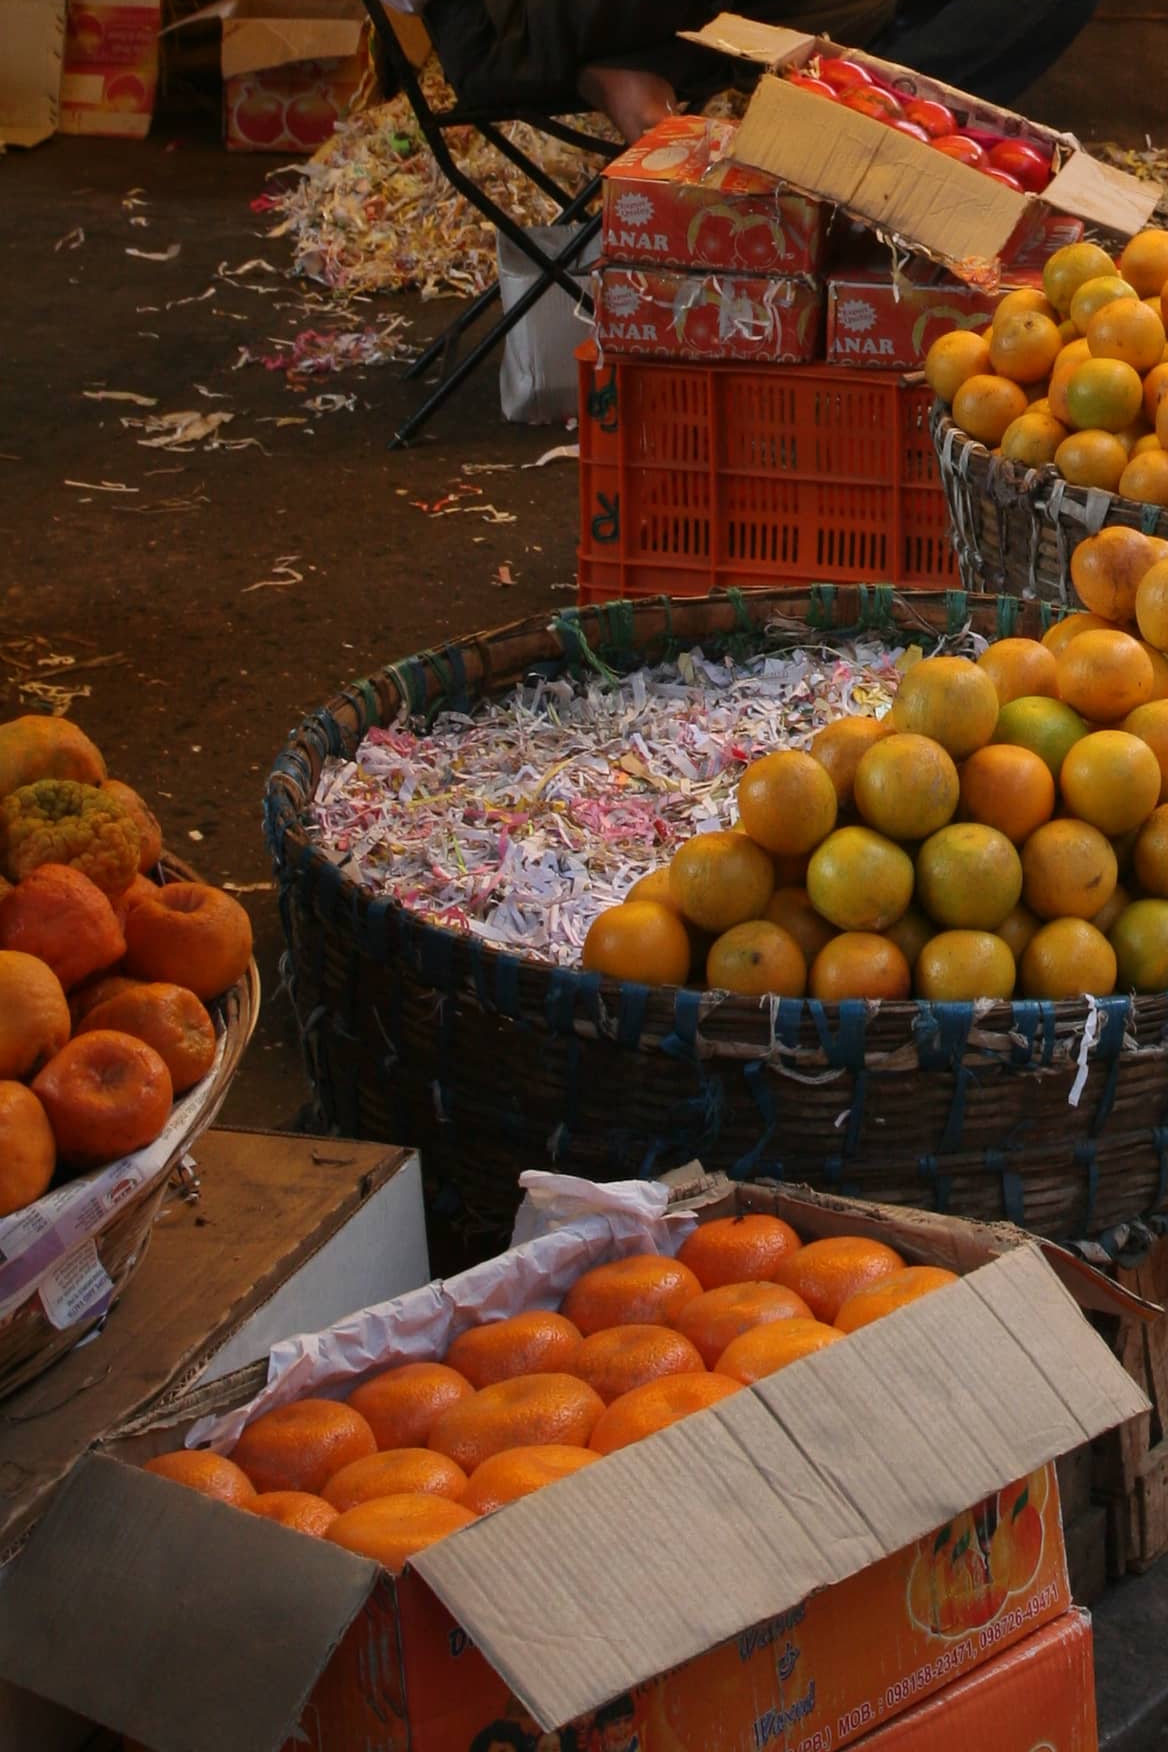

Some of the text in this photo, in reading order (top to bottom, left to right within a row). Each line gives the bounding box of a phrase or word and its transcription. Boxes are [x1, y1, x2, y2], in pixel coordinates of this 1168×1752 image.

[604, 228, 670, 252] ANAR
[829, 337, 896, 355] ANAR
[838, 1703, 876, 1738] MOB.
